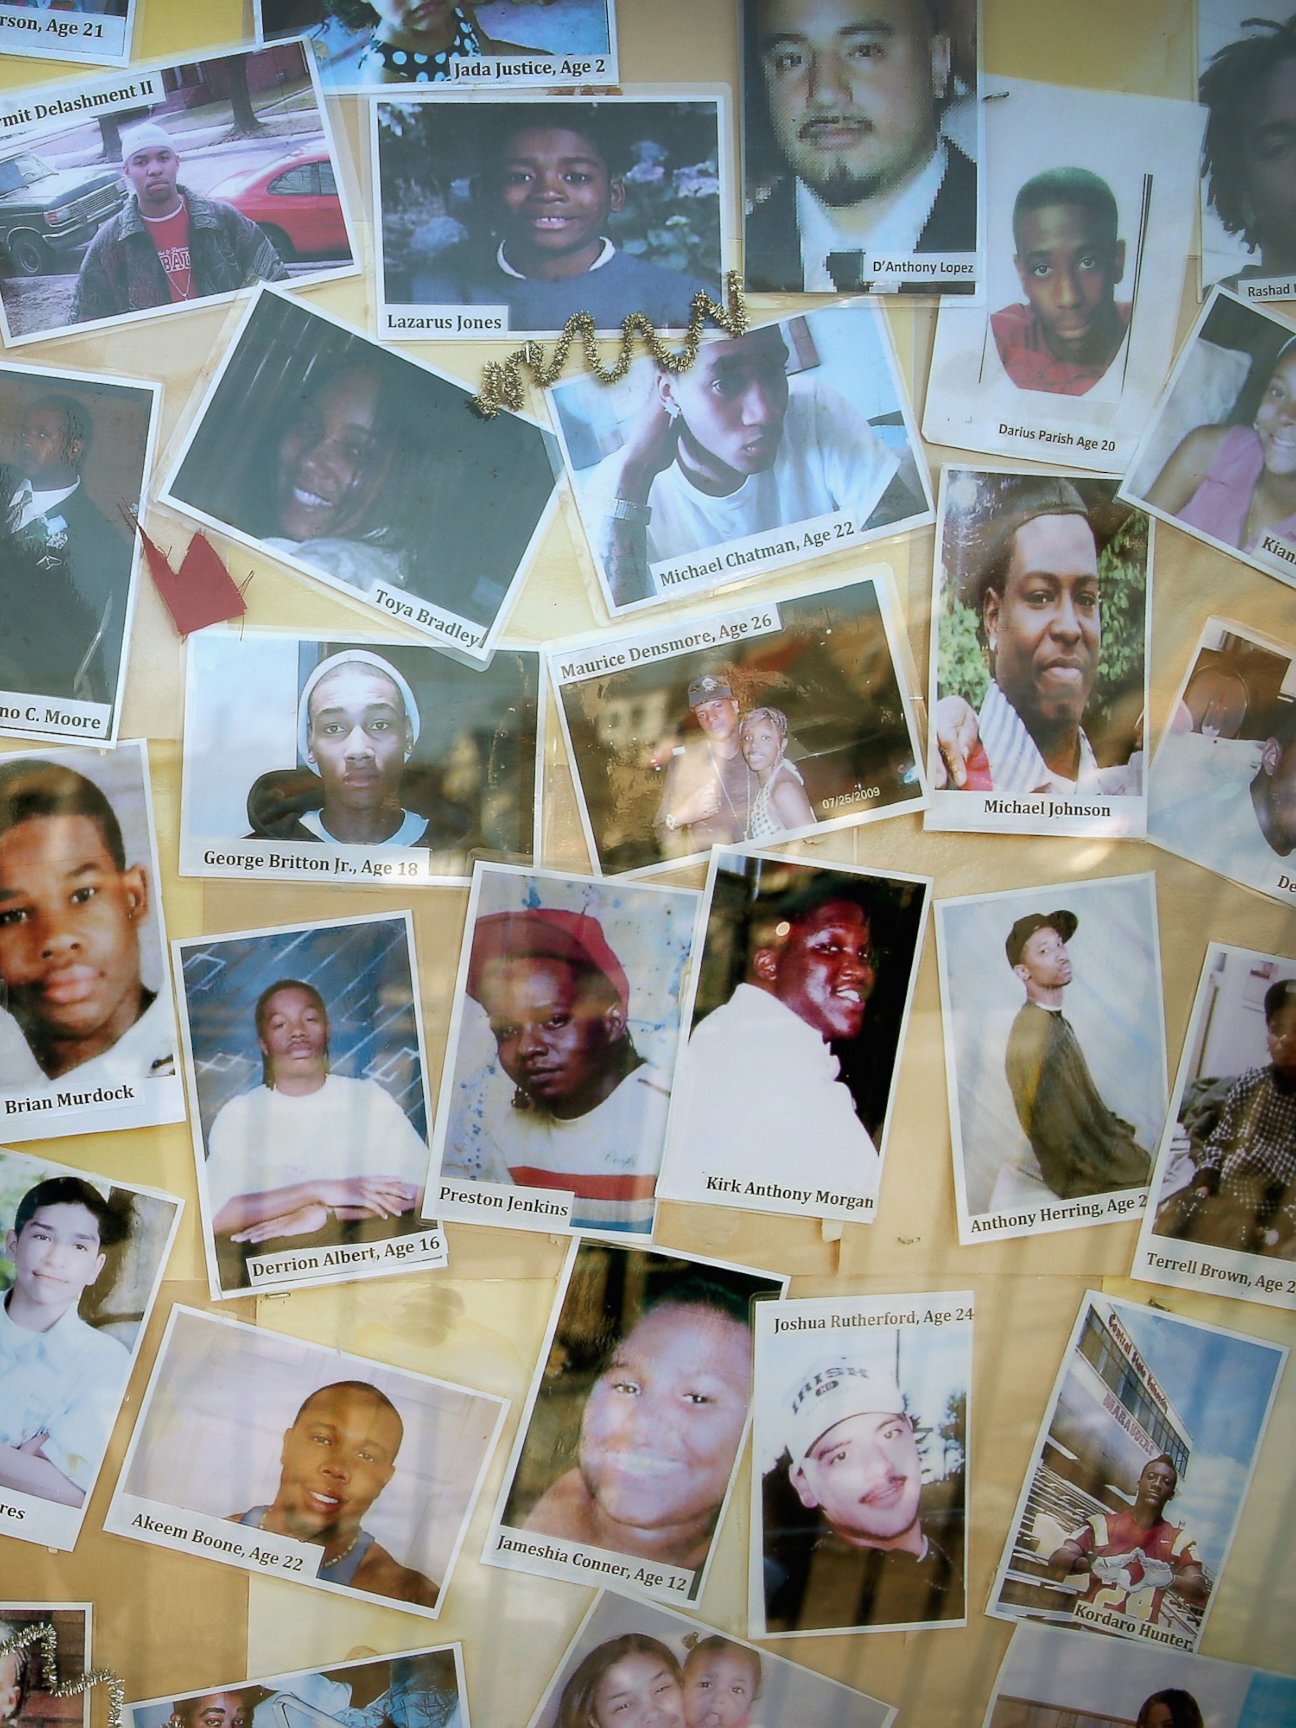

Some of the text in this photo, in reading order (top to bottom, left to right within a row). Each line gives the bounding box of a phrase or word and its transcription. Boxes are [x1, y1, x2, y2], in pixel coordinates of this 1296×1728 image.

[45, 18, 78, 37] Age
[82, 22, 103, 38] 21
[454, 58, 605, 79] Jada Justice, Age 2
[34, 85, 137, 119] Delashment
[139, 80, 153, 95] II
[873, 260, 973, 275] D'Anthony Lopez
[1247, 283, 1290, 297] Rashad
[387, 314, 501, 331] Lazarus Jones
[998, 423, 1115, 451] Darius Parish Age 20
[659, 521, 854, 586] Michael Chatman, Age 22
[375, 589, 481, 644] Toya Bradley
[560, 613, 771, 678] Maurice Densmore, Age 26
[25, 707, 39, 721] C.
[43, 709, 100, 729] Moore
[821, 786, 880, 808] 07/25/2009
[984, 799, 1110, 817] Michael Johnson
[204, 850, 418, 877] George Britton Jr., Age 18
[4, 1084, 134, 1114] Brian Murdock
[439, 1186, 568, 1216] Preston Jenkins
[706, 1176, 873, 1210] Kirk Anthony Morgan
[971, 1194, 1147, 1232] Anthony Herring, Age 2
[251, 1235, 439, 1276] Derrion Albert, Age 16
[1146, 1252, 1296, 1293] Terrell Brown, Age 2
[775, 1307, 974, 1334] Joshua Rutherford, Age 24
[131, 1513, 303, 1571] Akeem Boone, Age 22
[496, 1535, 686, 1591] Jameshia Conner, Age 12
[1074, 1602, 1136, 1632] Kordaro
